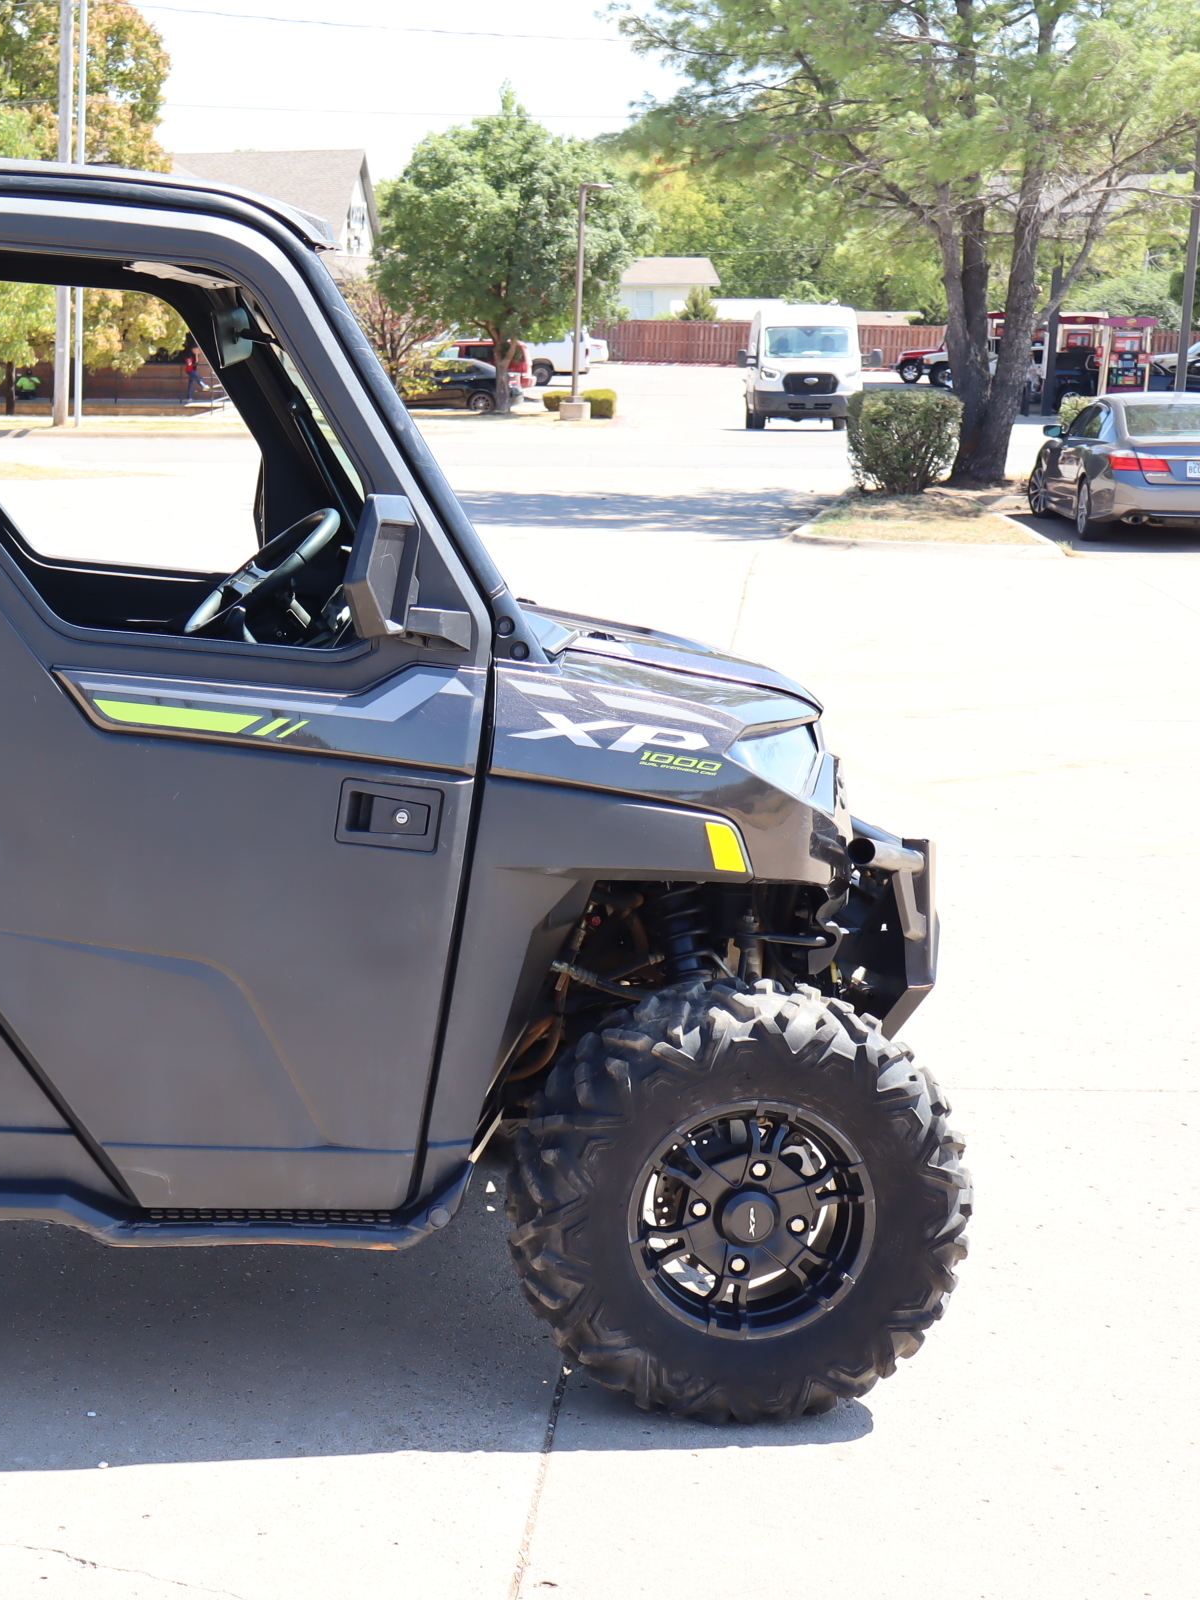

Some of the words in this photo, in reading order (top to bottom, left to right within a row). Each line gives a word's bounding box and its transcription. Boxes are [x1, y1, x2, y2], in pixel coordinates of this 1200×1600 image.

[506, 711, 710, 753] XP
[640, 751, 722, 772] 1000
[660, 764, 699, 774] OVERHEAD
[749, 1206, 756, 1238] XP
